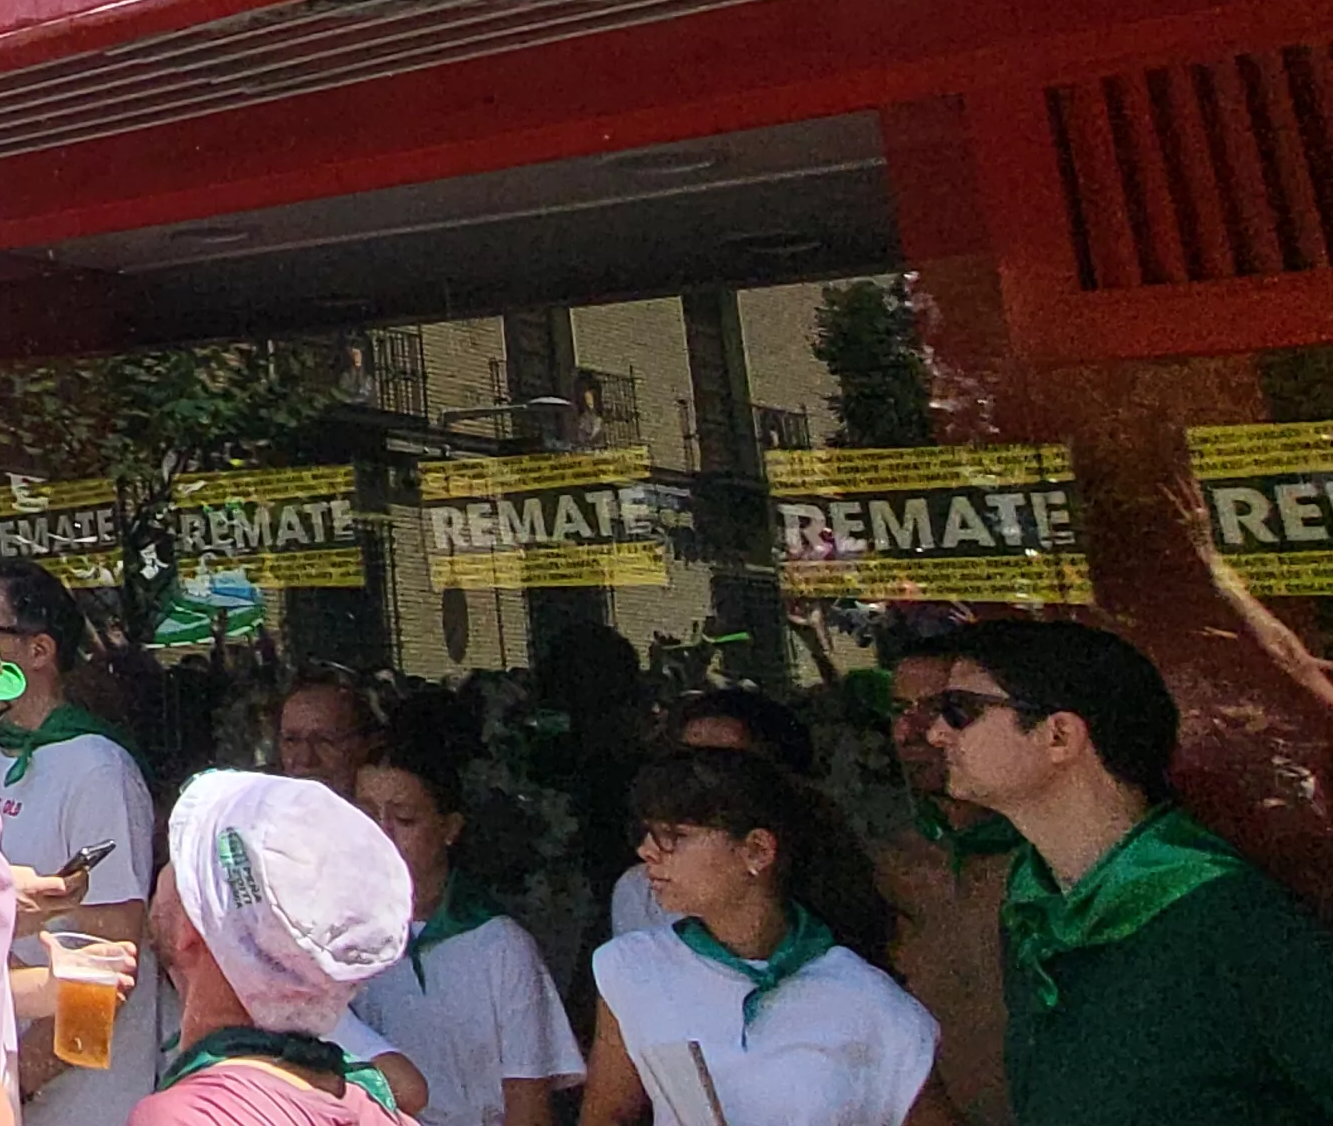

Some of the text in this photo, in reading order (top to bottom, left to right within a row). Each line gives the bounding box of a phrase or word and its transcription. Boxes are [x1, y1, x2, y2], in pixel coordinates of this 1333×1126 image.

[179, 499, 355, 553] REMATE
[429, 485, 652, 549] REMATE
[778, 490, 1076, 556] REMATE
[1208, 480, 1333, 545] RE
